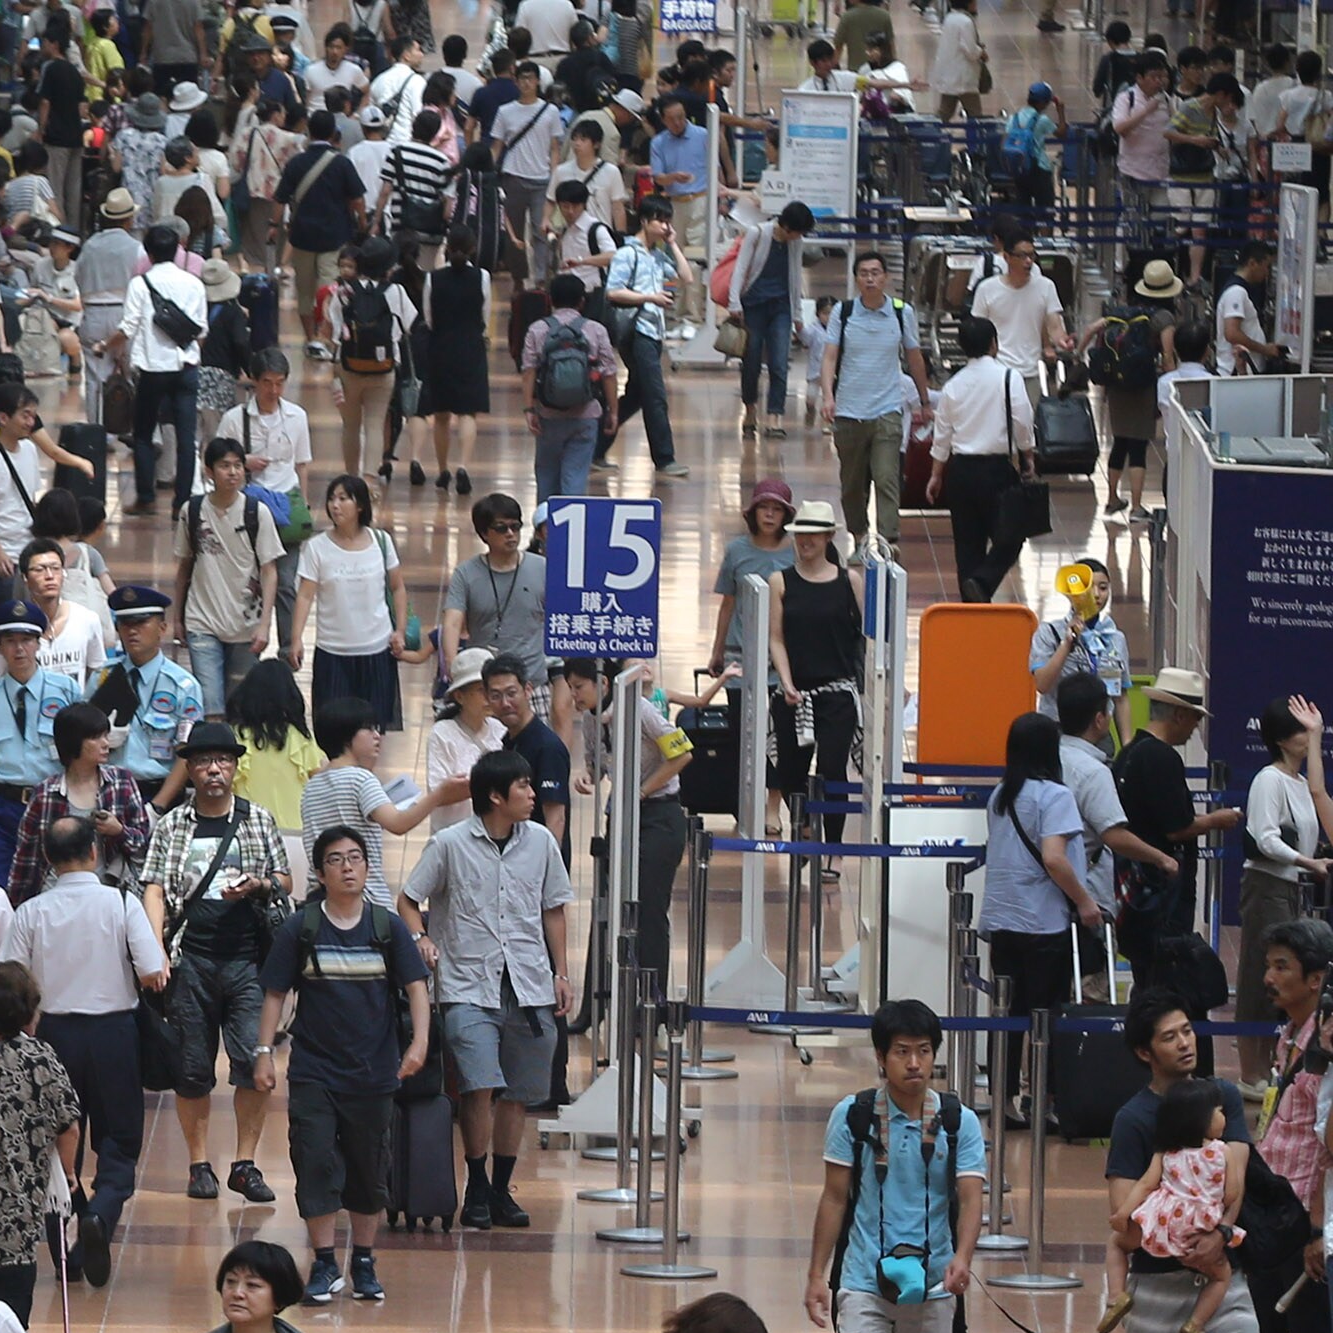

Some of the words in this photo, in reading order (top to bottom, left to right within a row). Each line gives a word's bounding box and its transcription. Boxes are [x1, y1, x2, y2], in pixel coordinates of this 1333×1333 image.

[661, 0, 715, 18] 手荷物
[662, 19, 715, 31] BAGGAGE
[551, 503, 656, 591] 15
[1246, 570, 1333, 587] 羽田空港にご期待くだ
[580, 591, 623, 614] 購入
[1251, 596, 1266, 609] We
[1267, 599, 1303, 614] sincerely
[549, 613, 654, 637] 搭乗手続き
[1248, 611, 1261, 623] for
[1262, 616, 1277, 628] any
[1279, 614, 1333, 629] inconvenienc
[548, 637, 597, 654] Ticketing
[599, 639, 608, 651] &
[609, 639, 642, 652] Check
[643, 640, 654, 653] in
[937, 787, 957, 796] ANA
[754, 842, 776, 852] ANA
[899, 846, 921, 857] ANA
[746, 1012, 769, 1023] ANA
